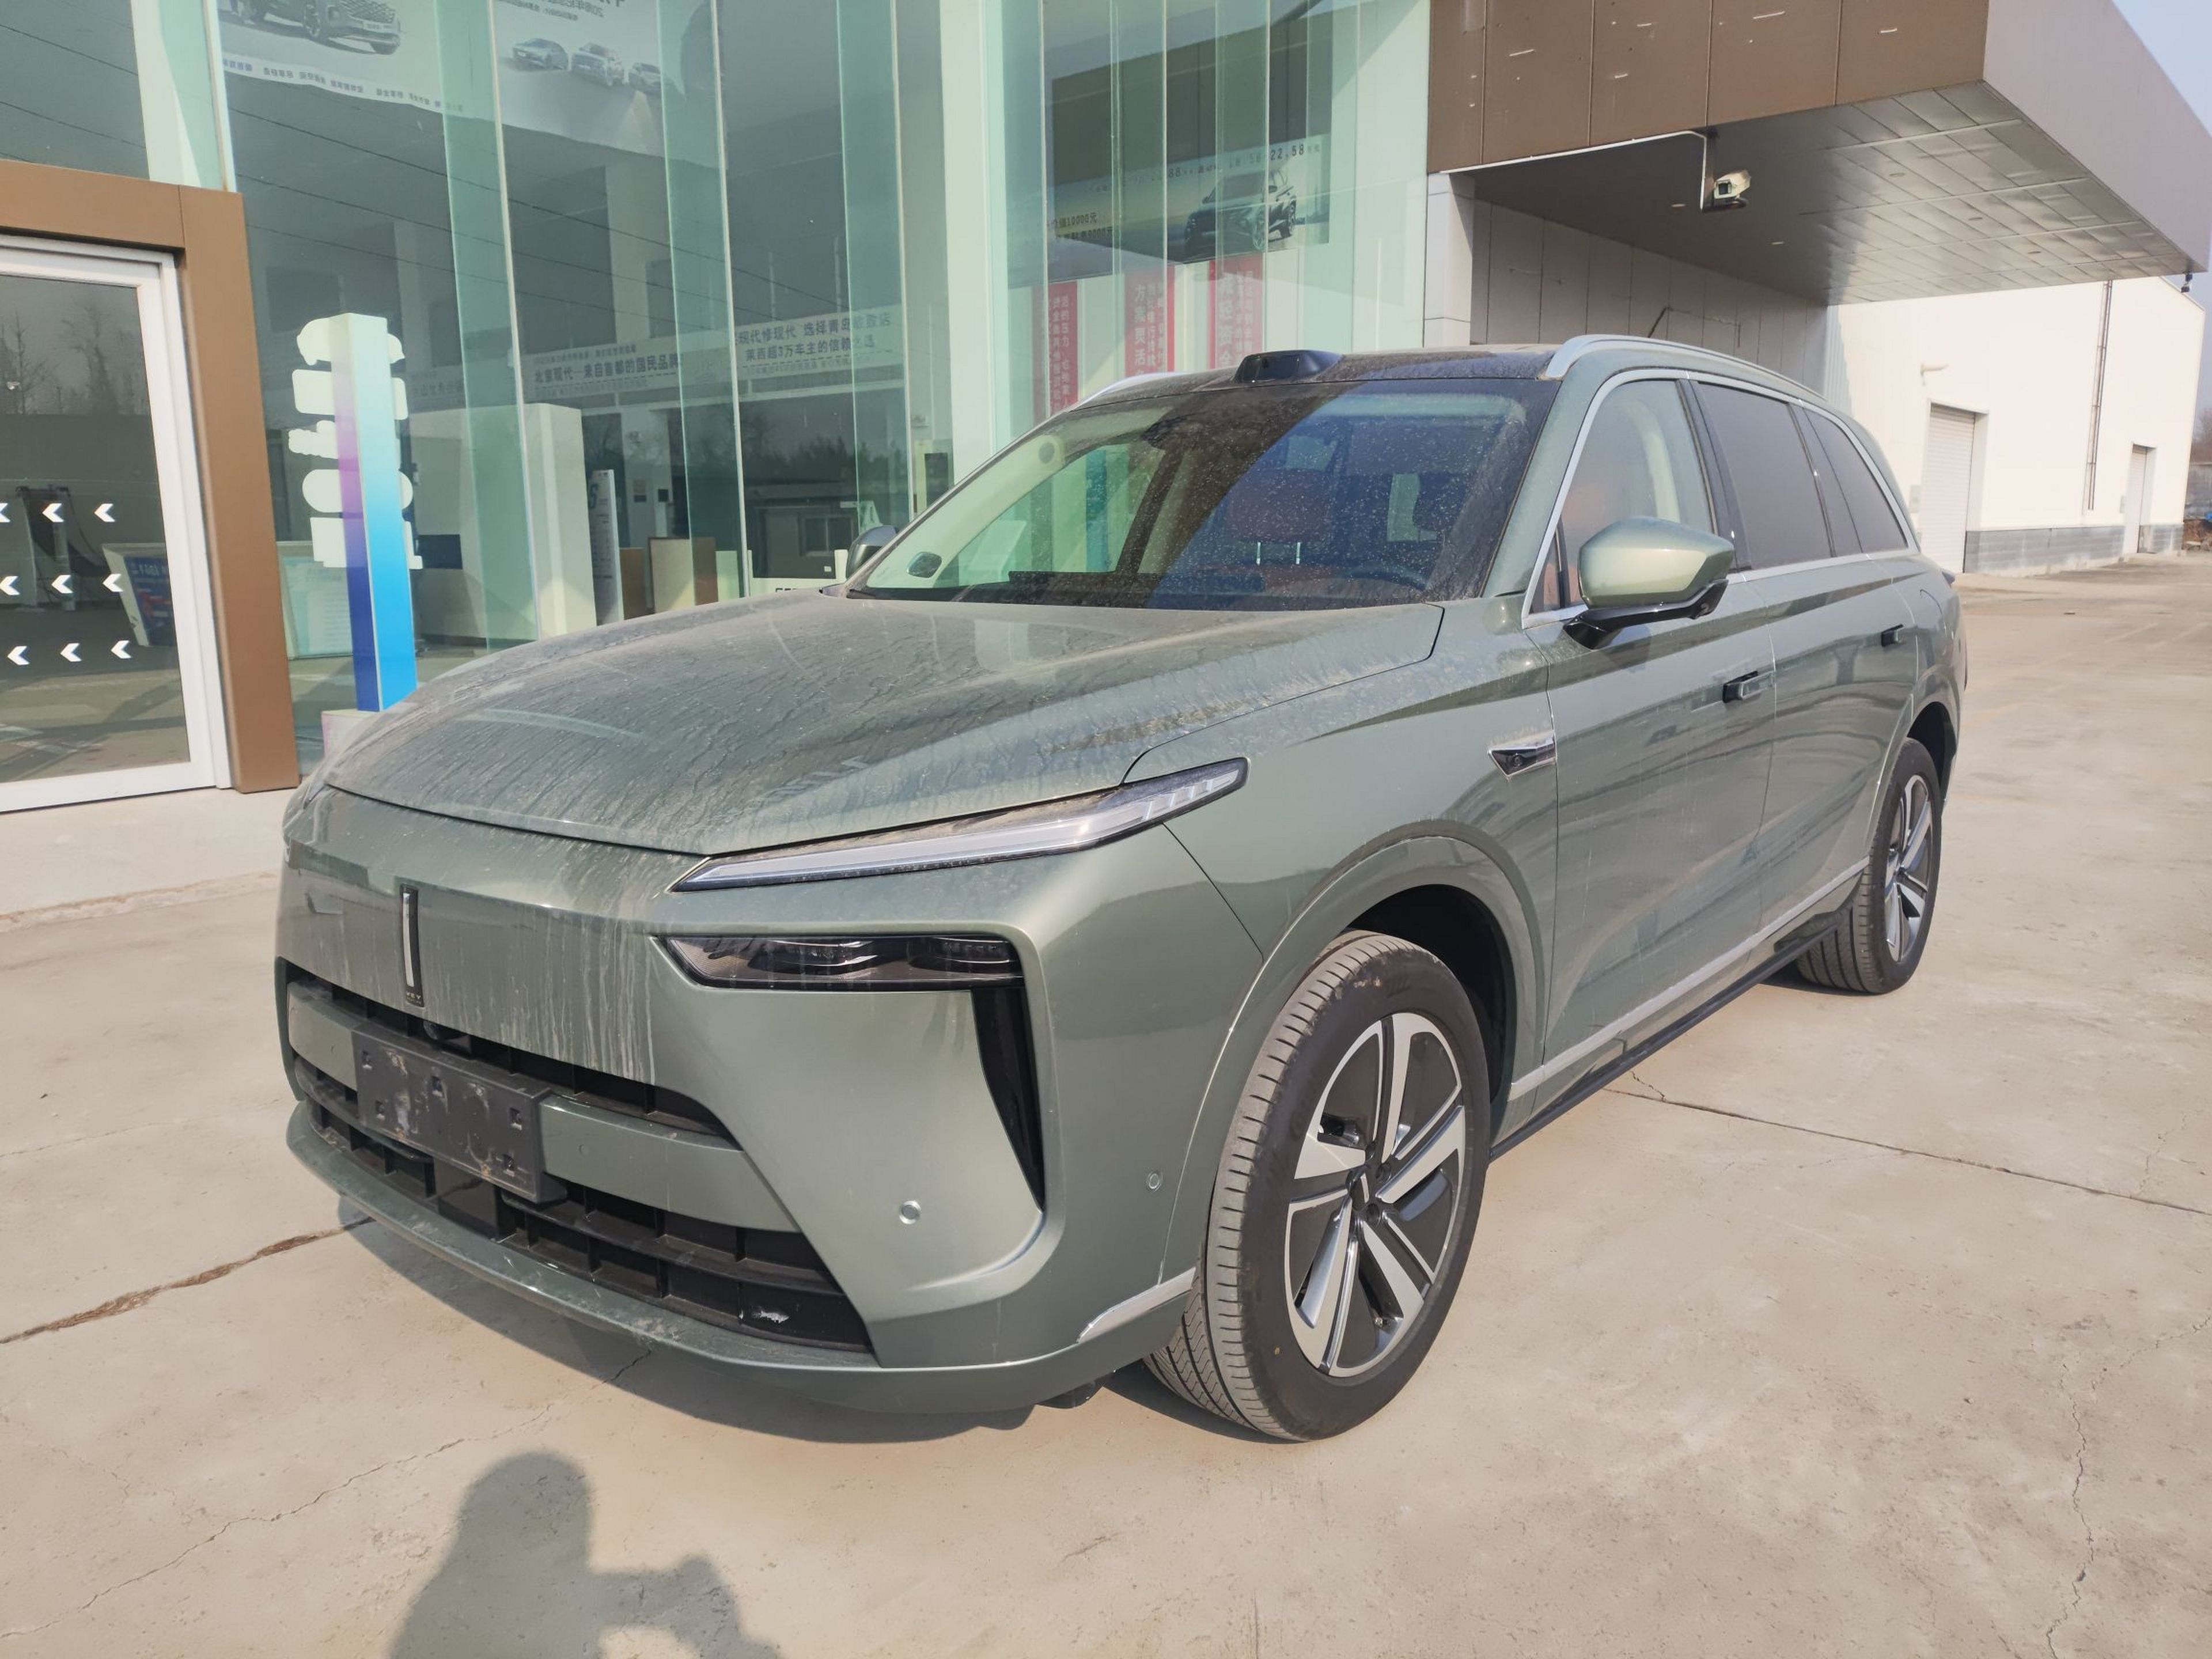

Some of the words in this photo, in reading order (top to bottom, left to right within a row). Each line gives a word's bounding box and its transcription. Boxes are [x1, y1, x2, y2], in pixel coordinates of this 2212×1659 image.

[736, 325, 797, 346] 现代修现代
